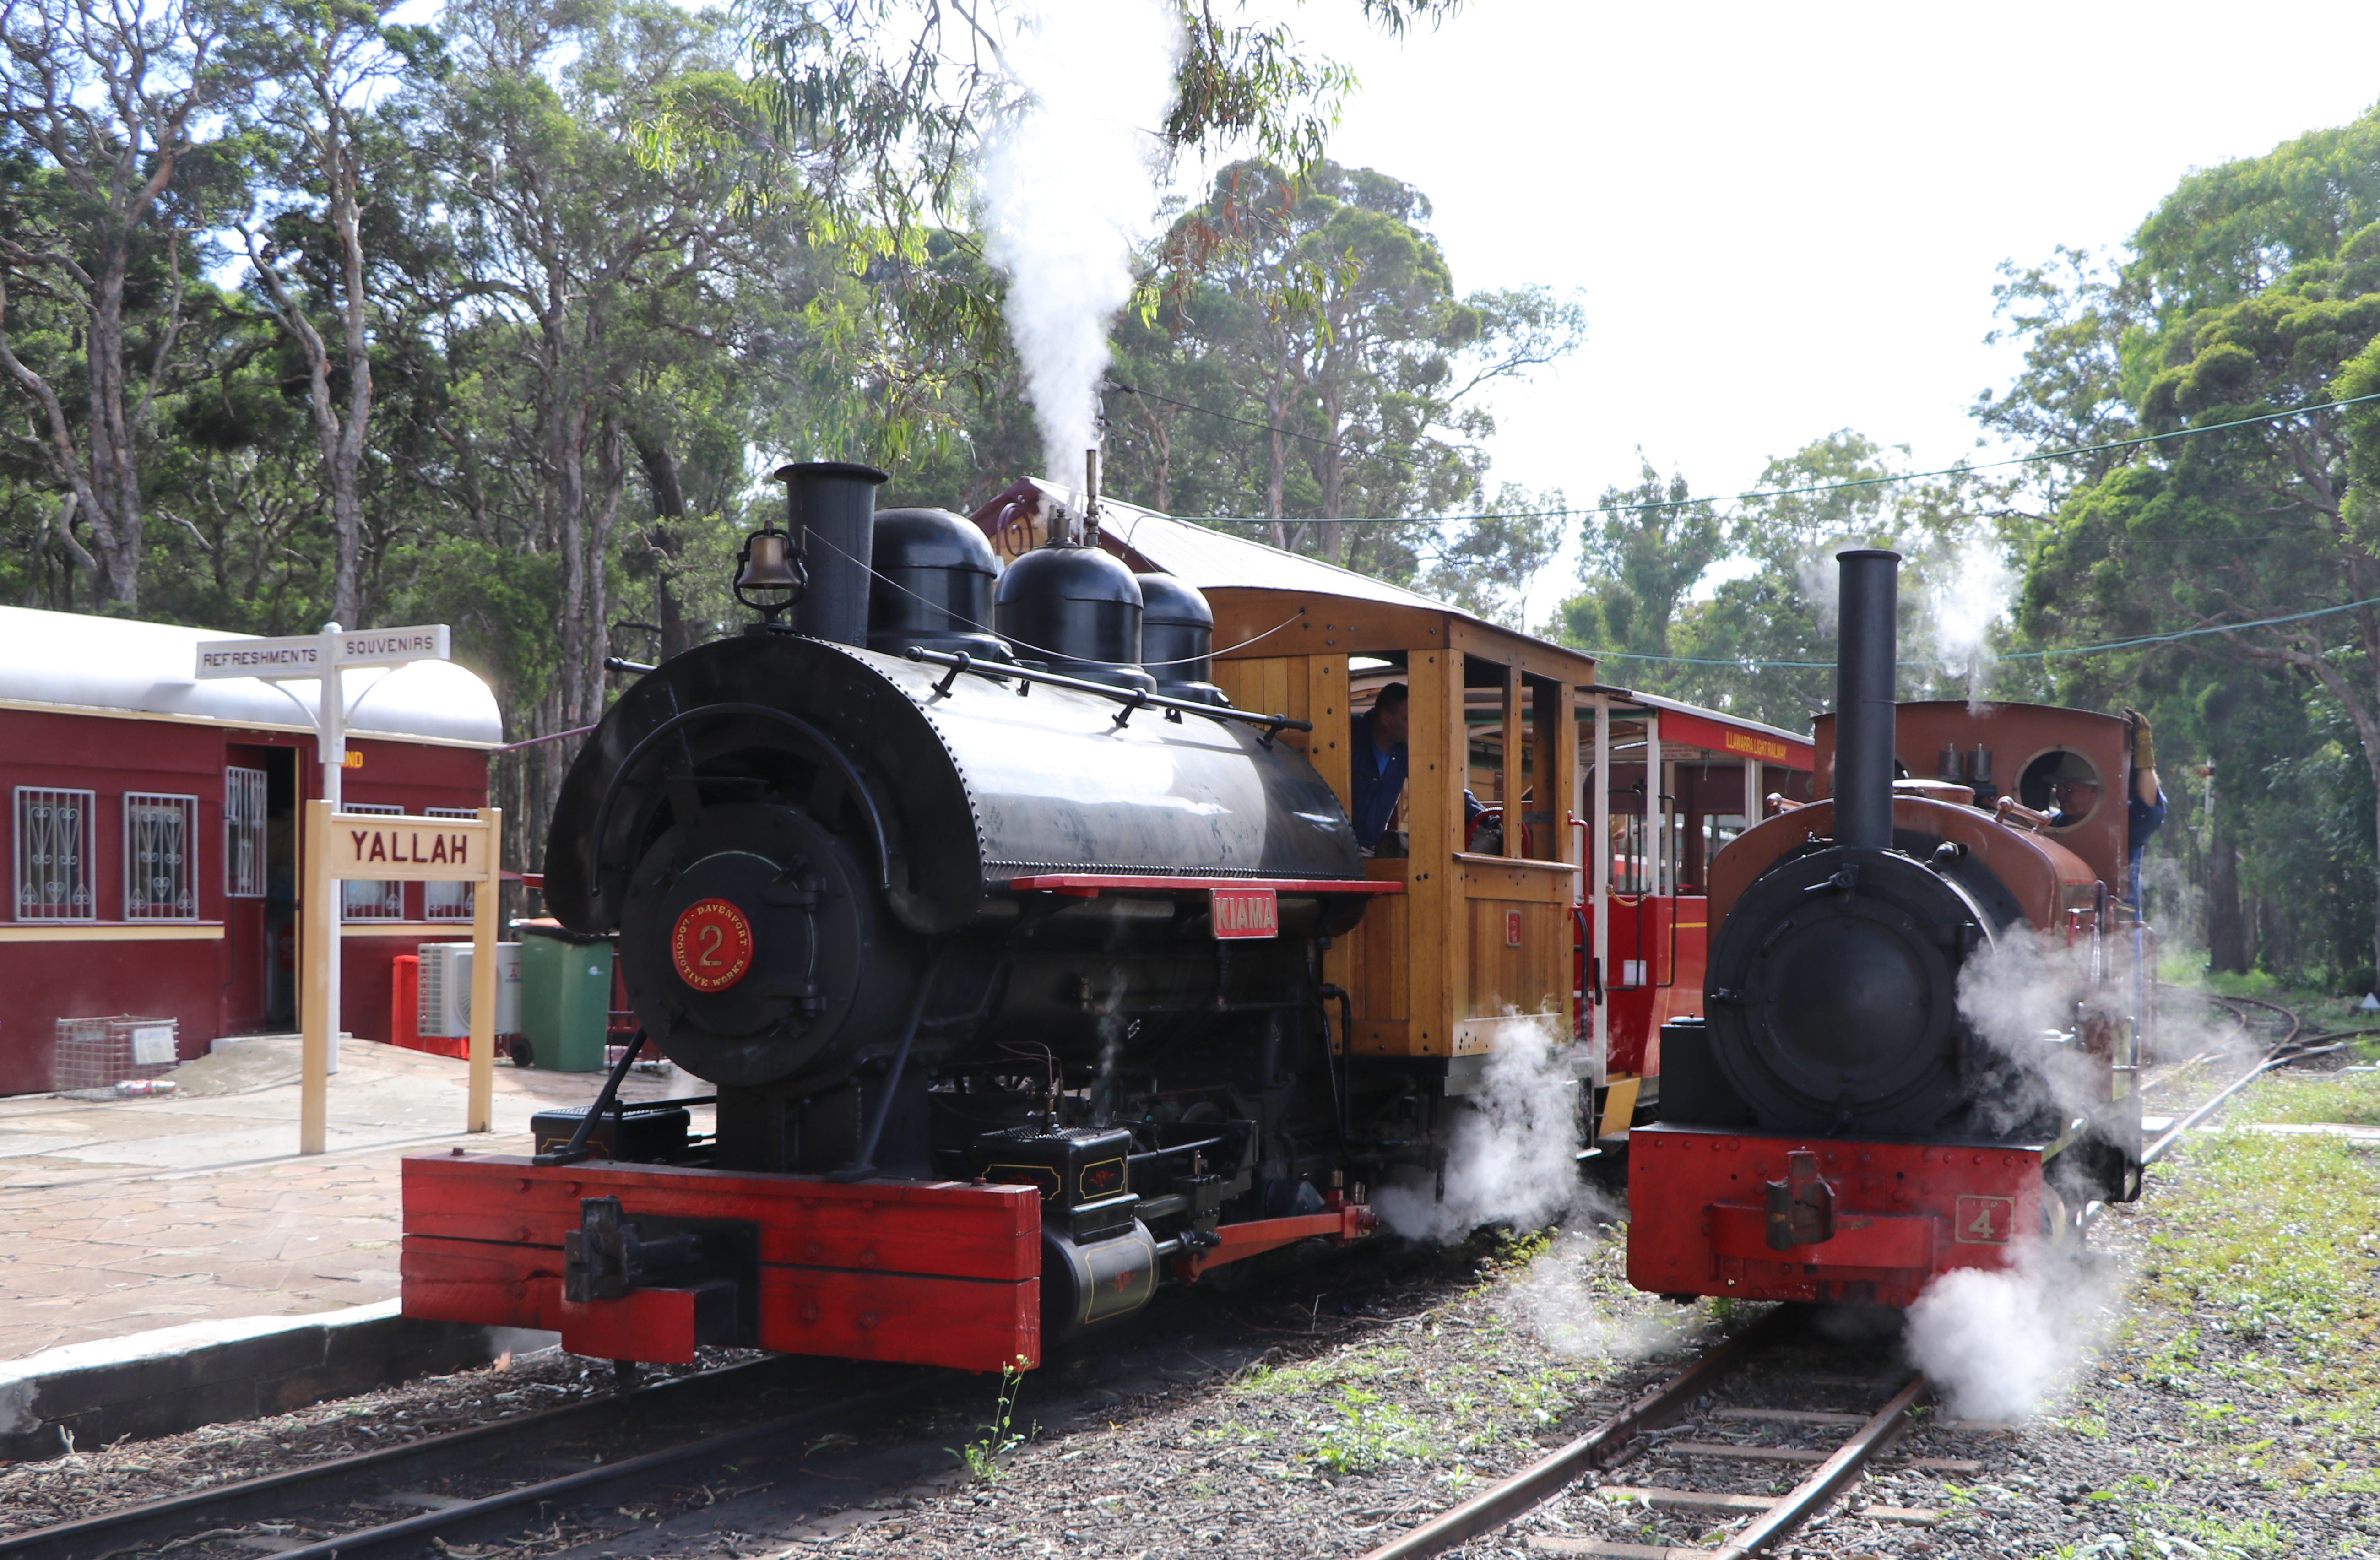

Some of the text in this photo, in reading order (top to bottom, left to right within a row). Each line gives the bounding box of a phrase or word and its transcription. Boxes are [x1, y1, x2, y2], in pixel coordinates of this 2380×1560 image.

[204, 649, 317, 666] REFRESHMENTS
[347, 636, 434, 655] SOUVENIRS
[340, 750, 363, 769] ND
[1726, 731, 1787, 760] ILLAWARRA LIGHT RAILWAY
[351, 830, 467, 864] YALLAH
[1215, 897, 1275, 930] KIAMA
[676, 904, 747, 986] DAVENPORT LOCOMOTIVE WORKS
[699, 925, 723, 966] 2
[1968, 1209, 1994, 1238] 4
